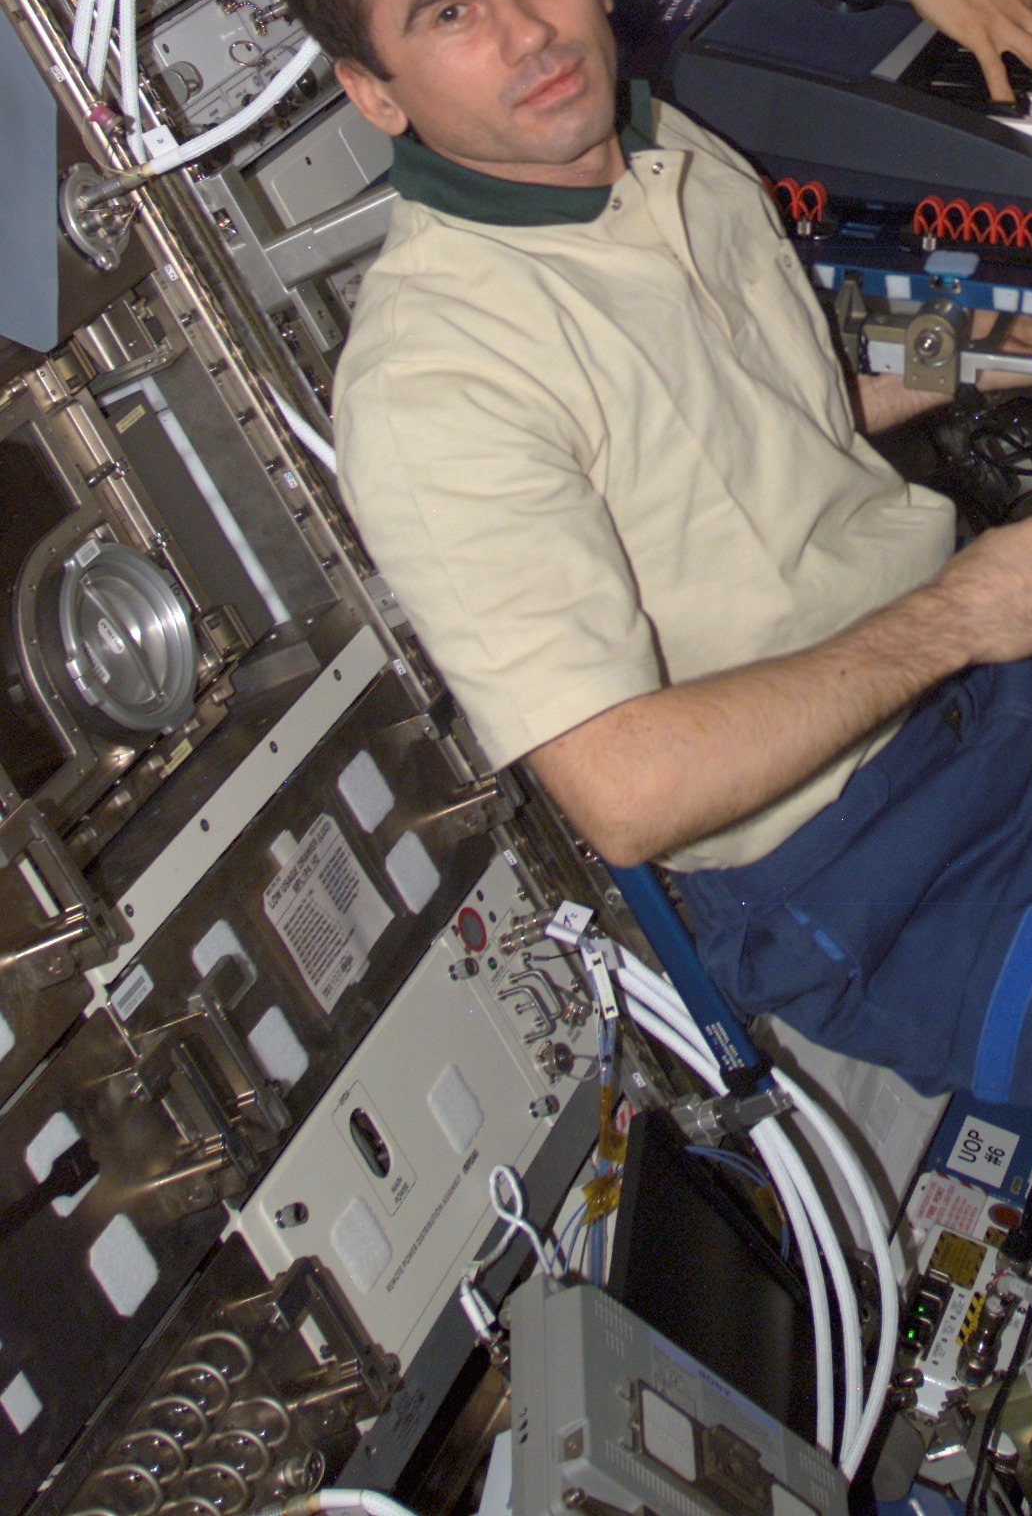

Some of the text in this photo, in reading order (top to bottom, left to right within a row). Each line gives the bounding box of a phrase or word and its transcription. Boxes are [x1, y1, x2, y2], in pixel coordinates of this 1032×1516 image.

[267, 888, 283, 909] LOW
[279, 865, 300, 893] USAGE
[296, 836, 318, 869] DRAWER
[958, 1128, 984, 1164] UOP
[985, 1145, 1006, 1167] #6
[932, 1186, 944, 1203] PORT
[385, 1264, 404, 1292] REMOTE
[401, 1243, 418, 1267] POWER
[415, 1202, 444, 1245] DISTRIBUTION
